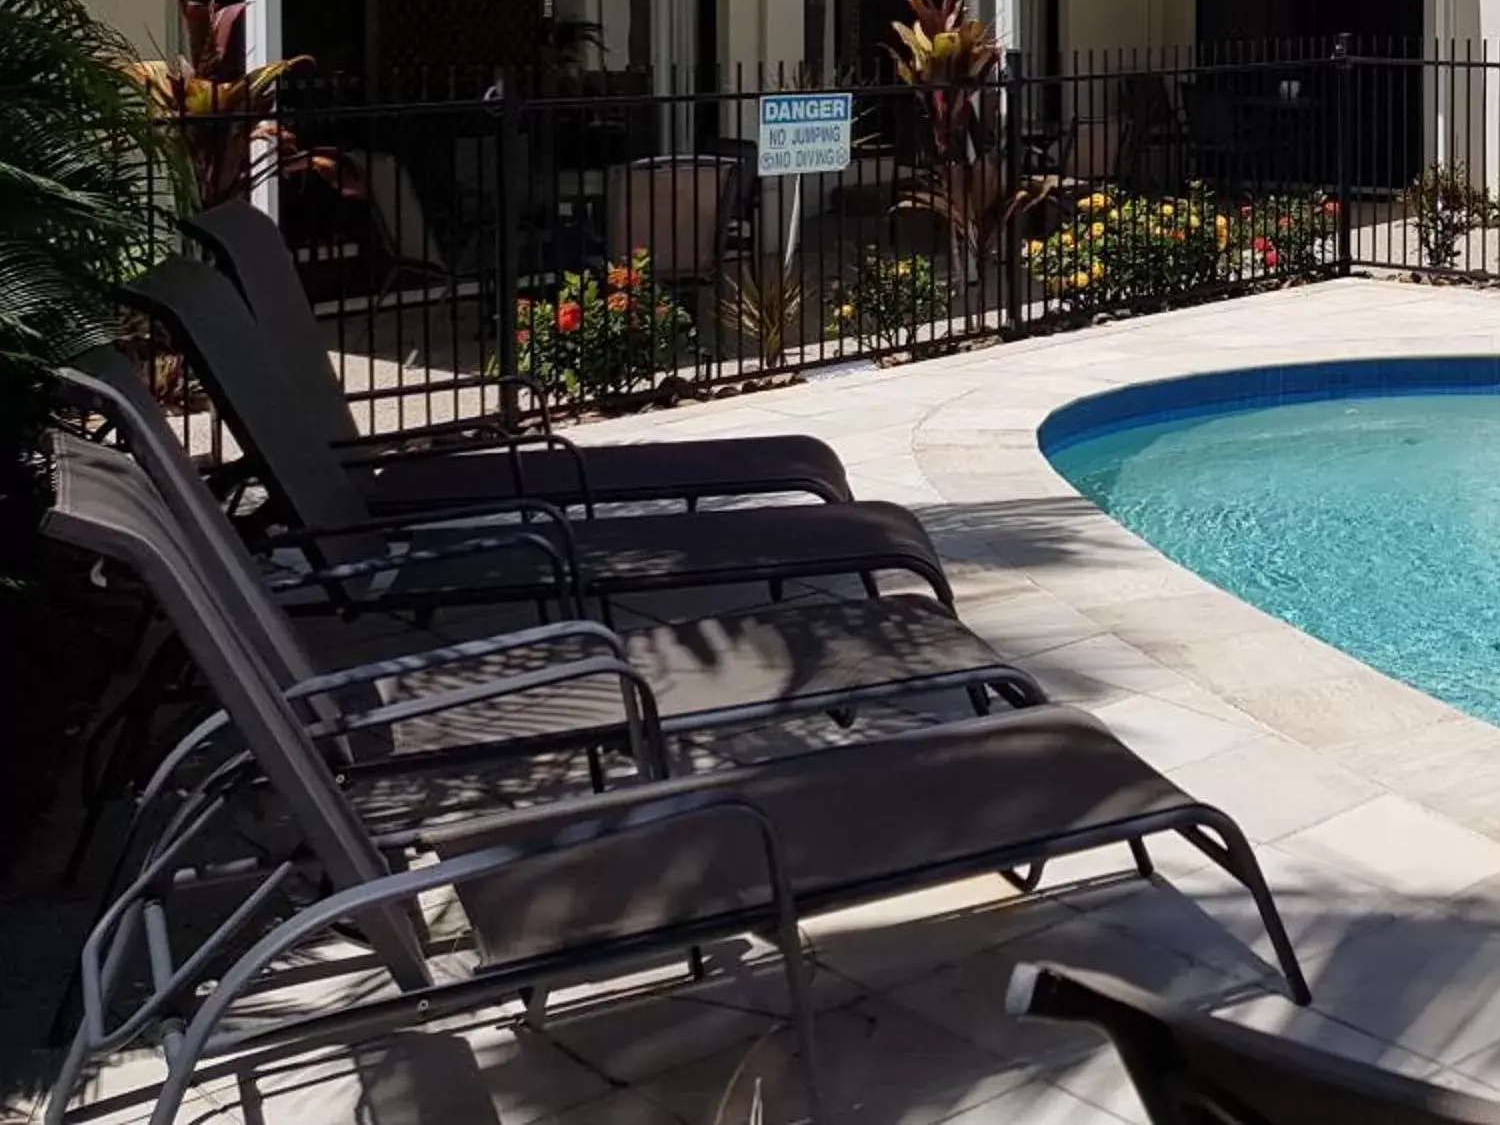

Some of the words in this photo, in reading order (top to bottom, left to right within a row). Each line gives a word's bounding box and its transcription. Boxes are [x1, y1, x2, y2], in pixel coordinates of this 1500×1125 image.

[765, 99, 845, 120] DANGER
[769, 128, 787, 148] NO
[791, 125, 840, 145] JUMPING
[775, 151, 791, 168] NO
[795, 149, 834, 167] DIVING
